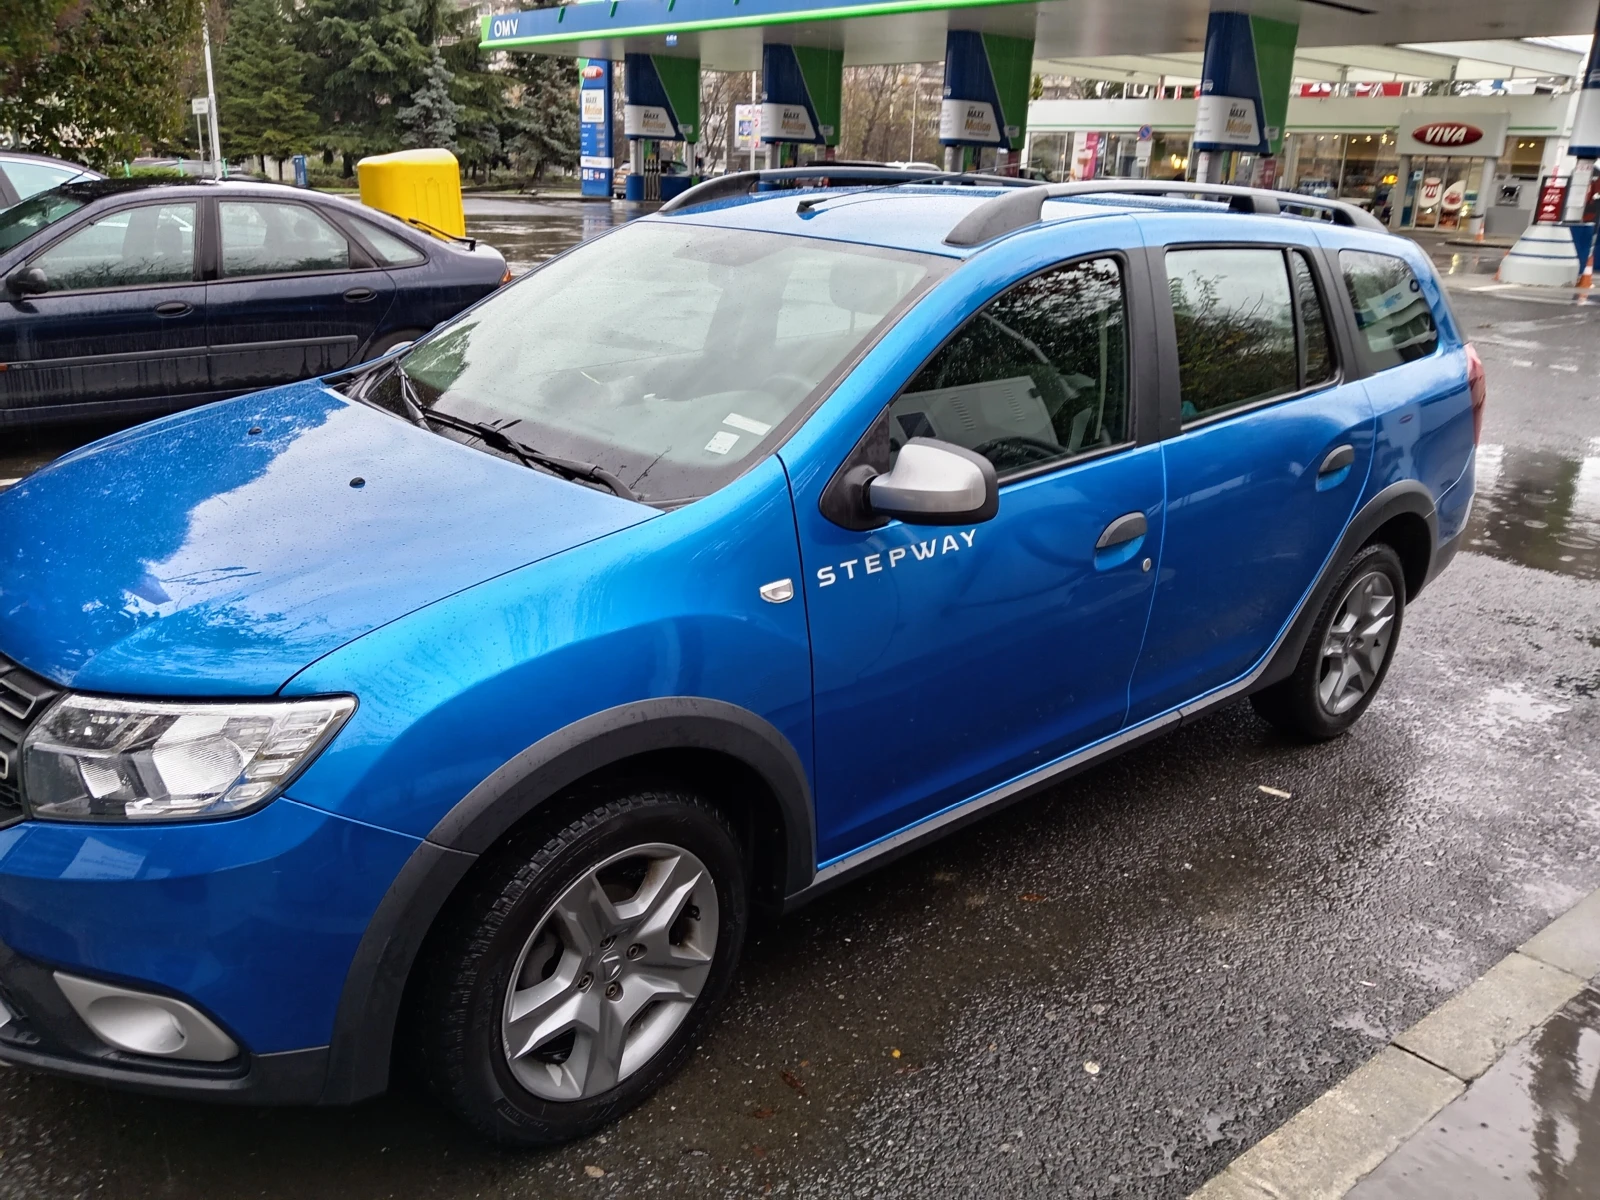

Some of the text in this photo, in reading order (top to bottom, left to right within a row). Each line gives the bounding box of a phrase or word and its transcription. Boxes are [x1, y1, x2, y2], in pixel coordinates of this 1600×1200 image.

[494, 18, 519, 38] OMV
[967, 109, 985, 118] MAXX
[1229, 107, 1247, 117] MAXX
[1425, 126, 1467, 143] VIVA
[817, 529, 977, 588] STEPWAY
